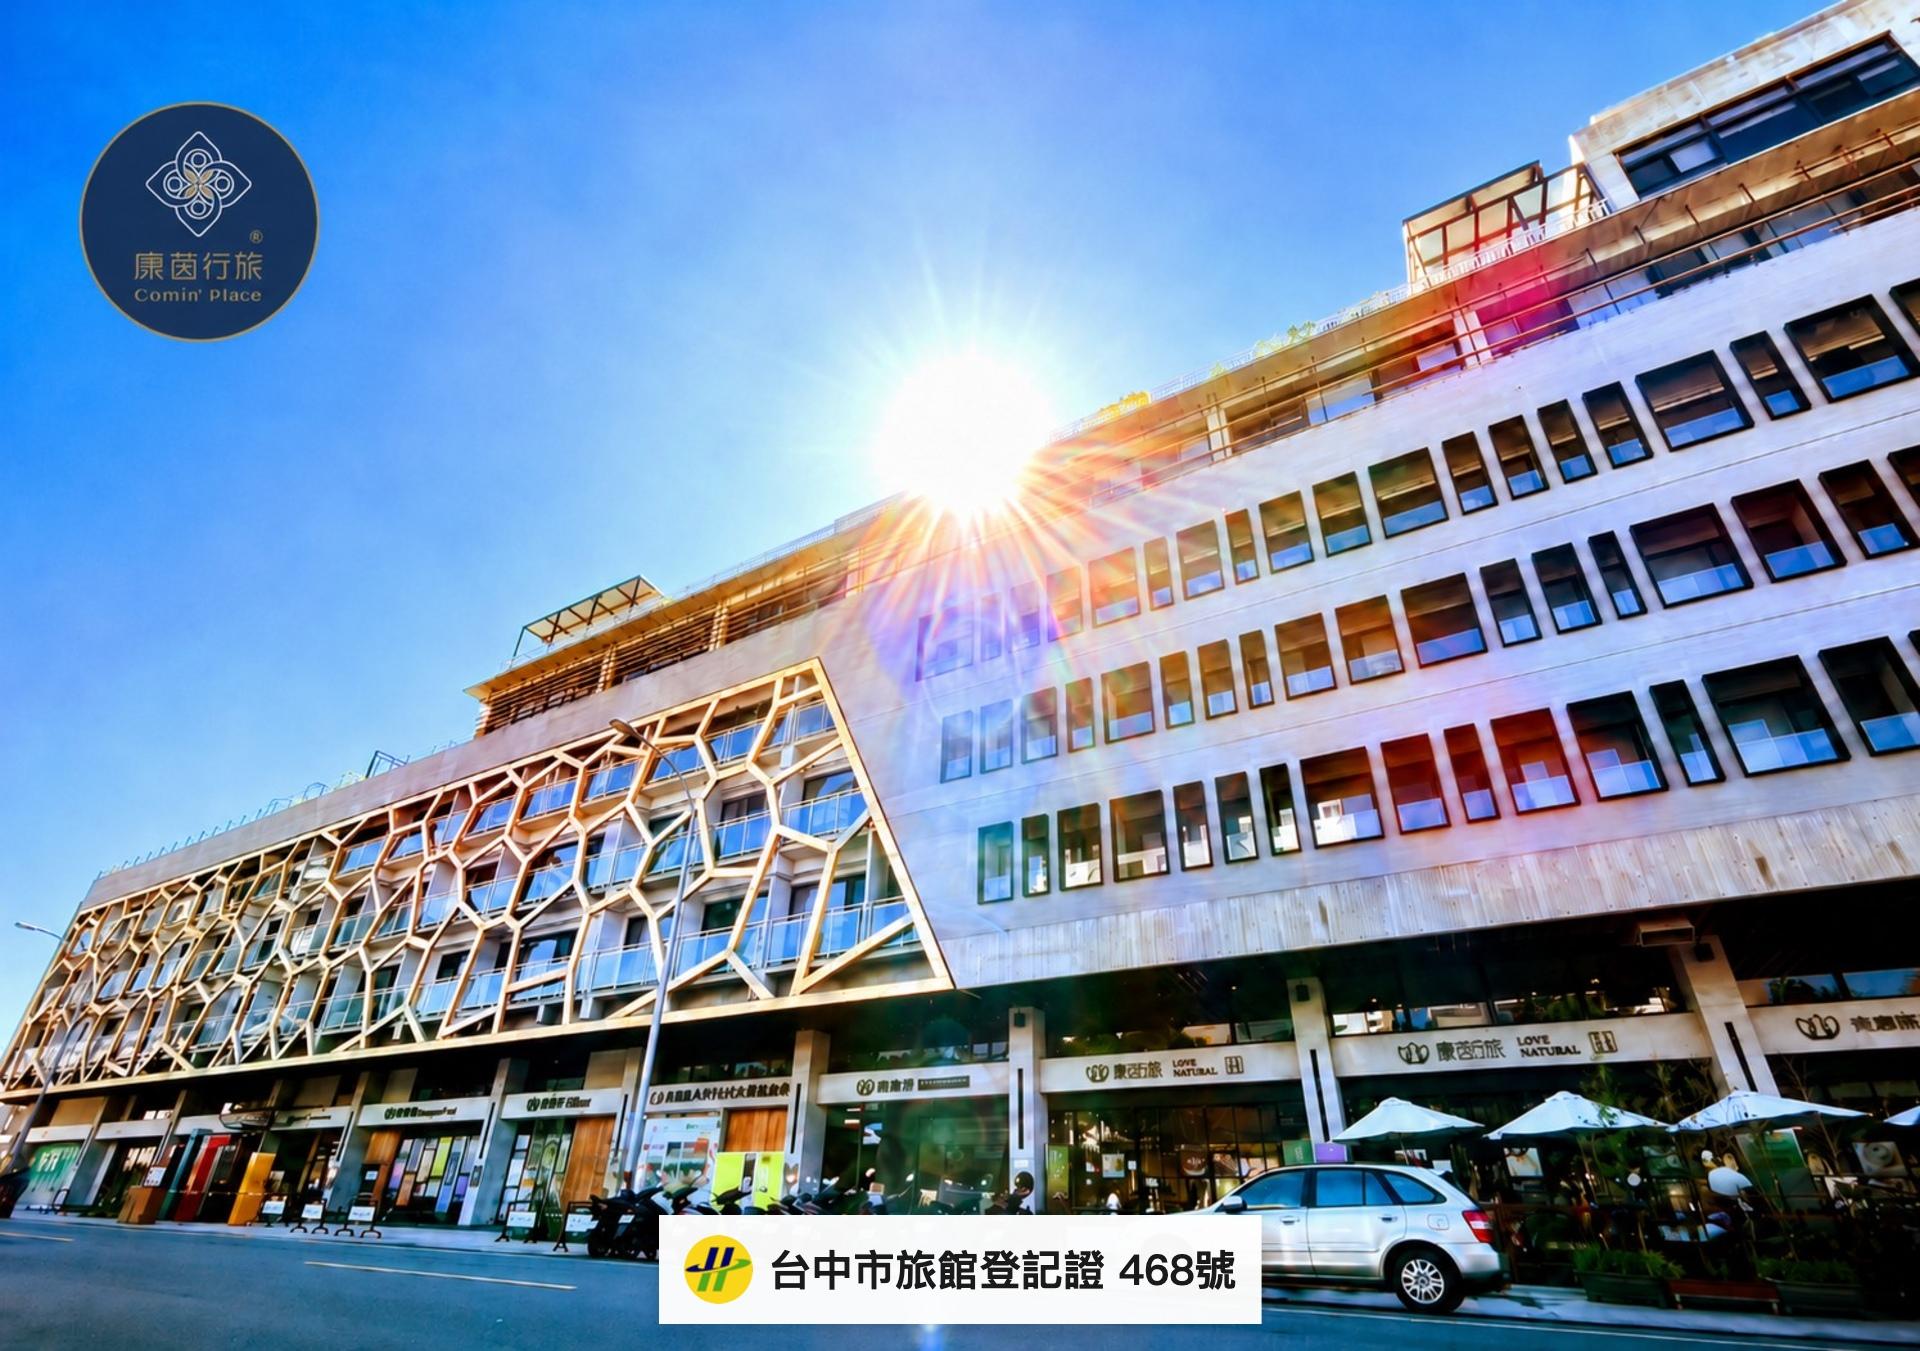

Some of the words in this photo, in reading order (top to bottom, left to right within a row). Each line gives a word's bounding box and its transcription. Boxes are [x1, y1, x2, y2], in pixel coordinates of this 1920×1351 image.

[1517, 1035, 1550, 1046] LOVE
[1519, 1045, 1581, 1058] NATURAL
[1172, 1058, 1197, 1068] LOVE
[1173, 1067, 1218, 1078] NATURAL
